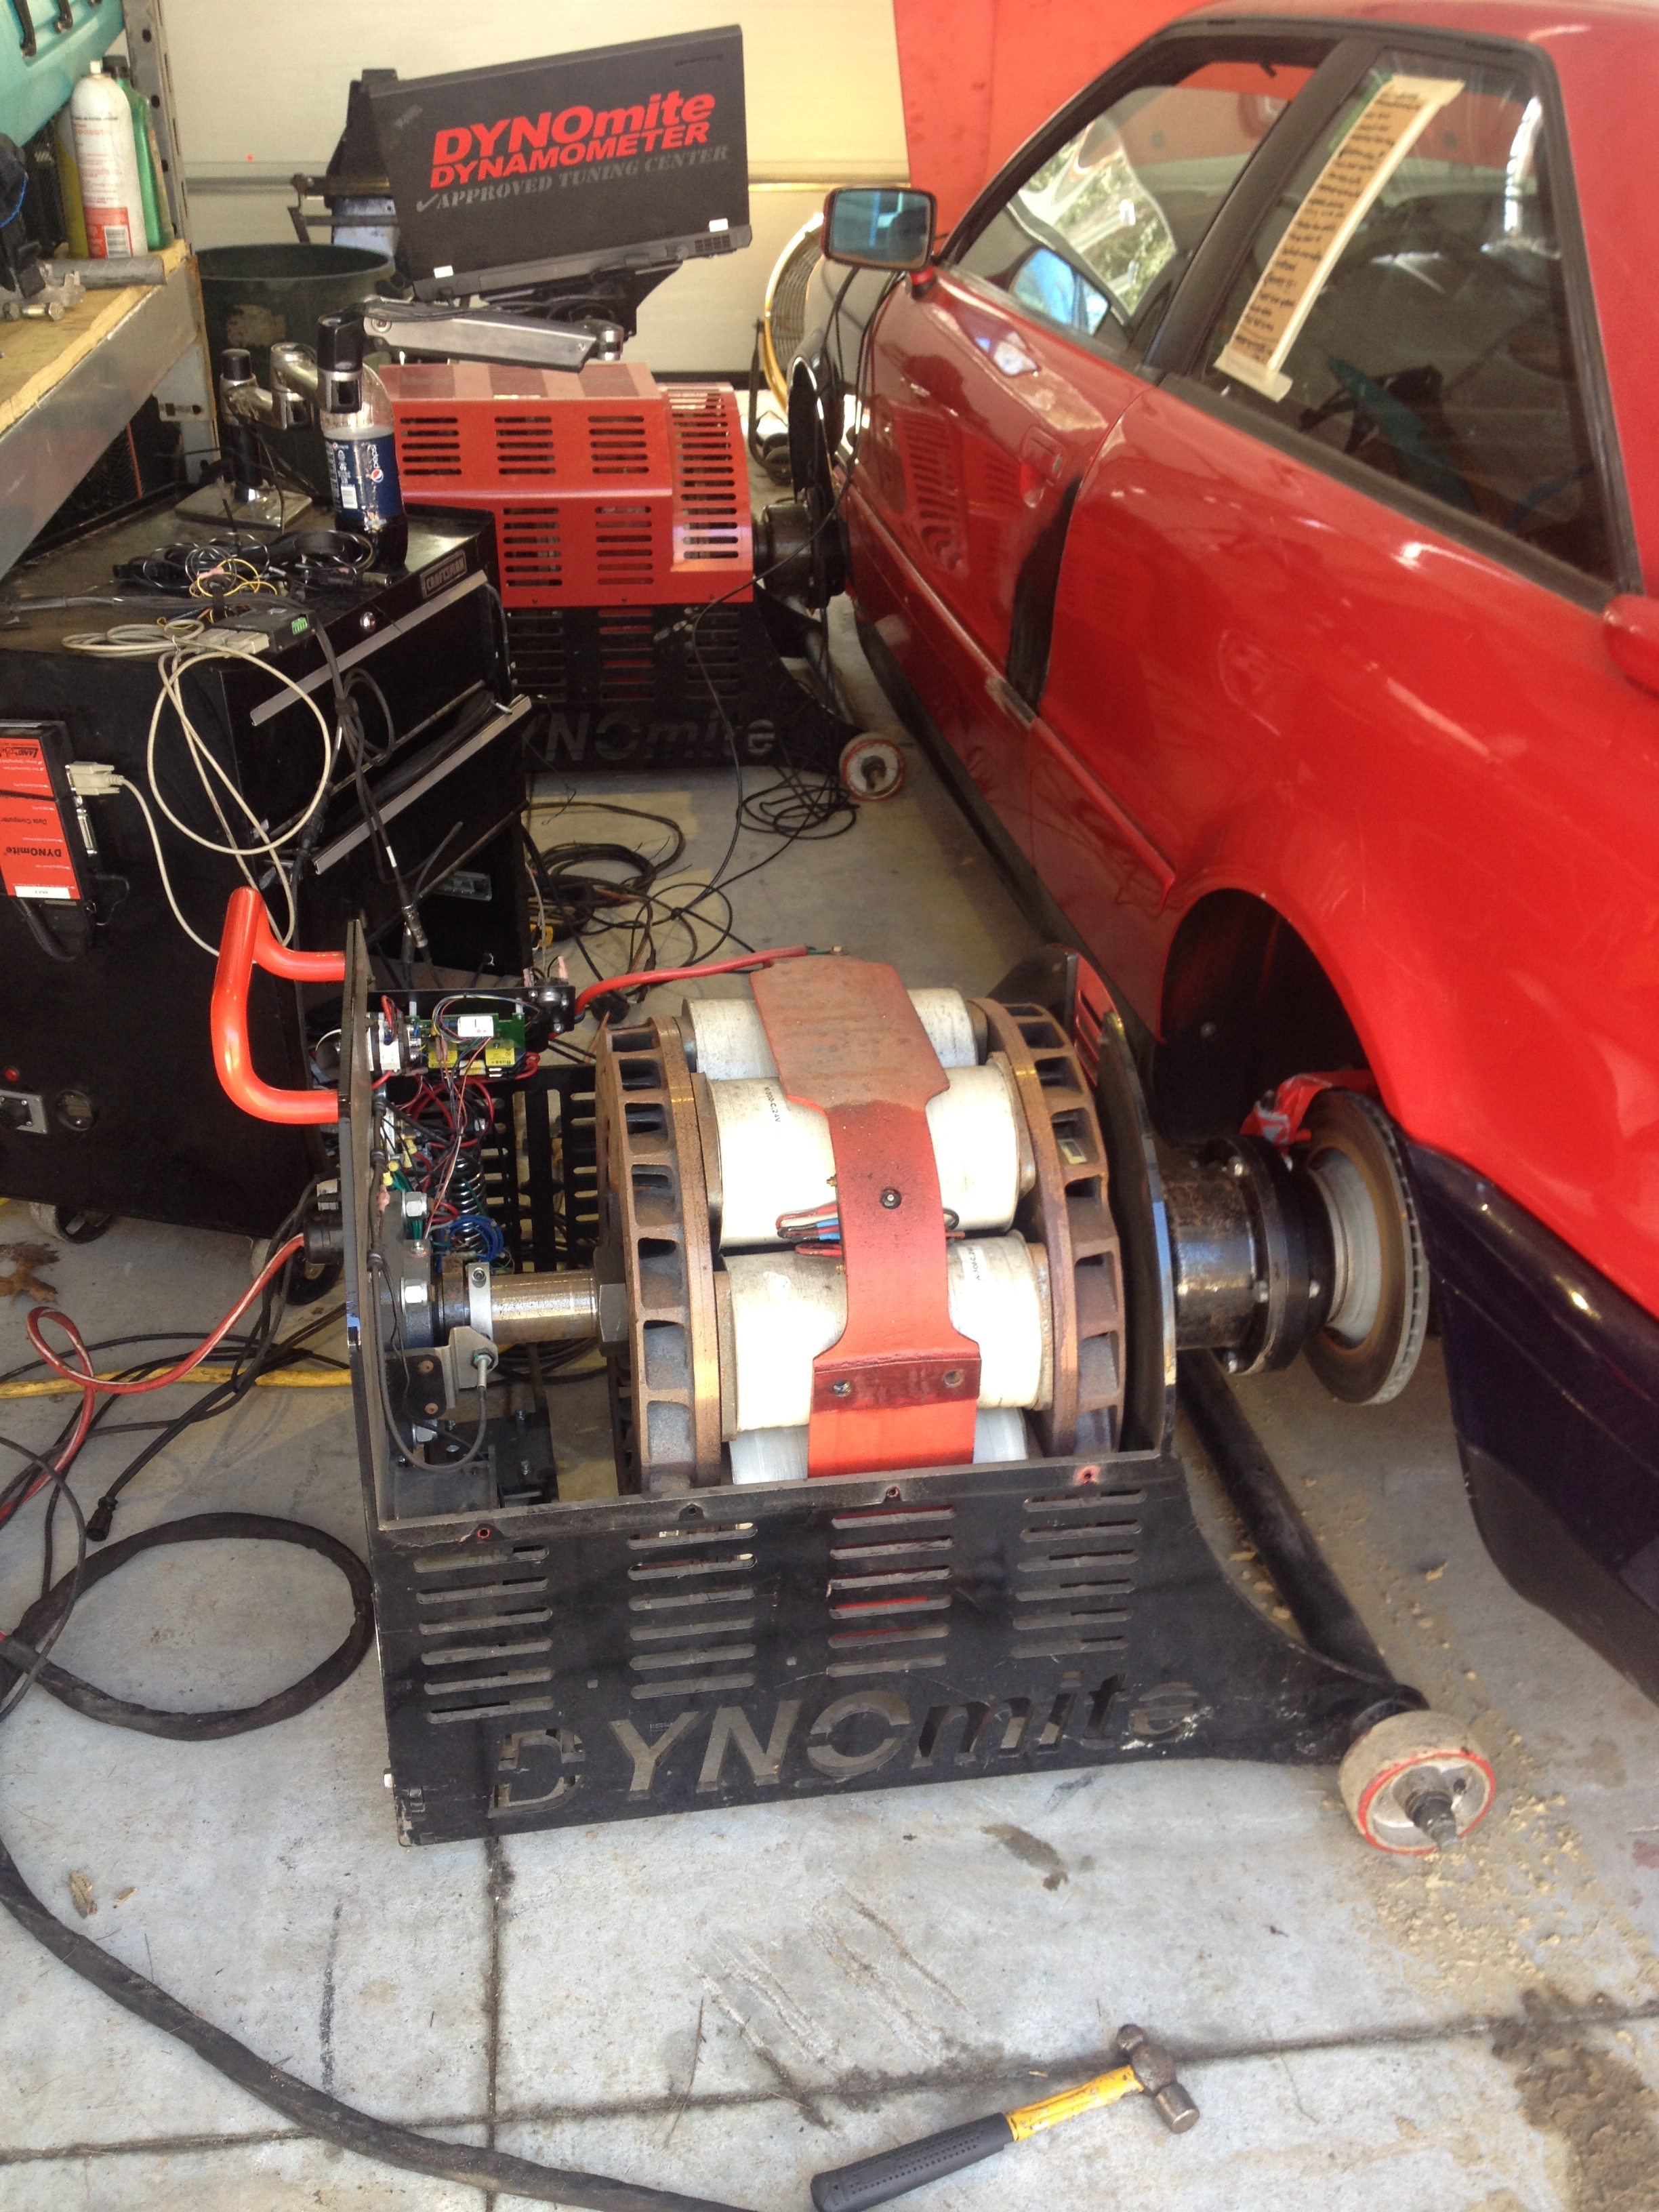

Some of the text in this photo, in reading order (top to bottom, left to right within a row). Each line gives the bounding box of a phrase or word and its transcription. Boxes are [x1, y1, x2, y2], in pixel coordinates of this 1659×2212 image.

[430, 121, 710, 189] DYNAMOMETER
[433, 90, 715, 165] DYNOmite
[436, 146, 729, 210] APPROVED TUNING CENTER
[371, 444, 380, 469] pepsi
[426, 557, 464, 591] CRAFTSMAN
[6, 846, 62, 857] DYNOmite
[487, 1673, 1200, 1820] DYNOmite
